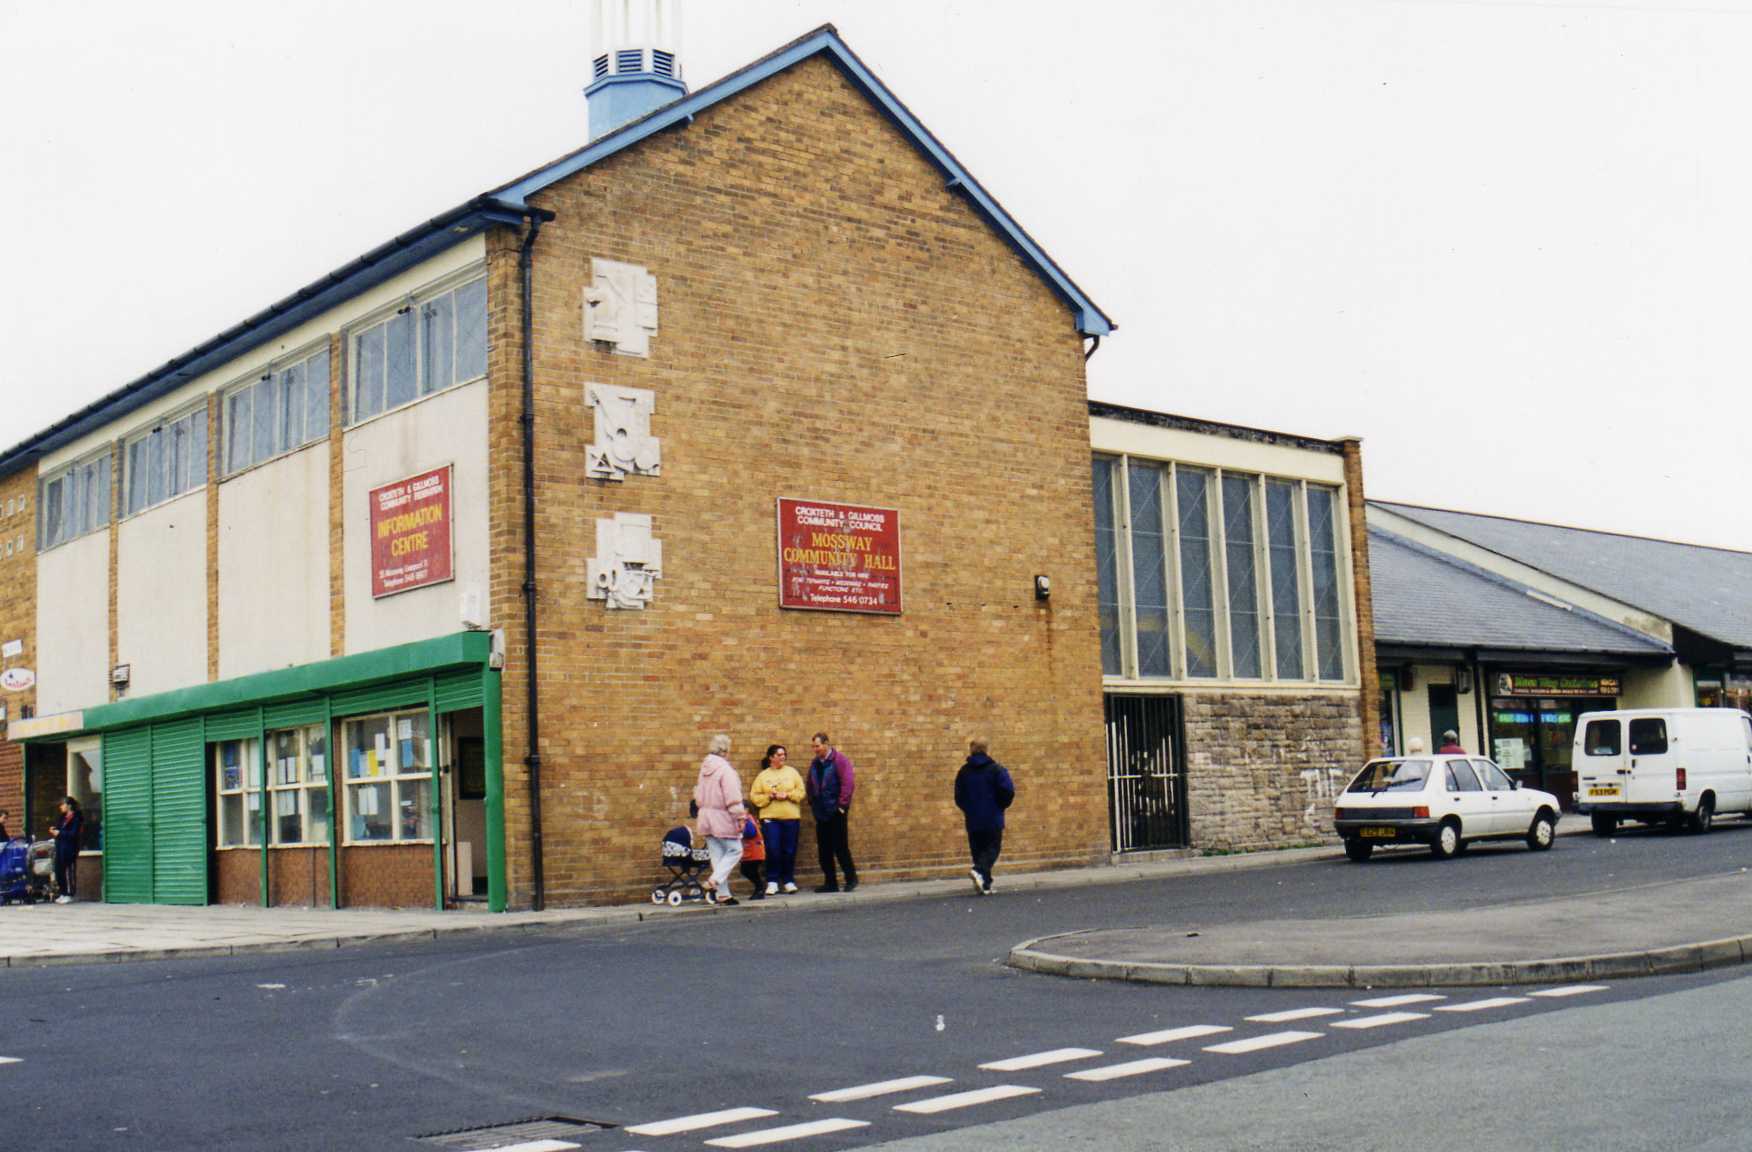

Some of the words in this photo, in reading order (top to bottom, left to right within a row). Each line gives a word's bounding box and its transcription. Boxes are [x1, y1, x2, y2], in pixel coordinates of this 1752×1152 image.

[377, 503, 443, 538] INFORMATION
[797, 516, 844, 528] COMMUNITY
[849, 520, 883, 532] COUNCIL
[839, 511, 845, 520] &
[391, 530, 429, 556] CENTRE
[811, 532, 872, 551] MOSSWAY
[784, 547, 858, 568] COMMUNITY
[864, 554, 896, 570] HALL
